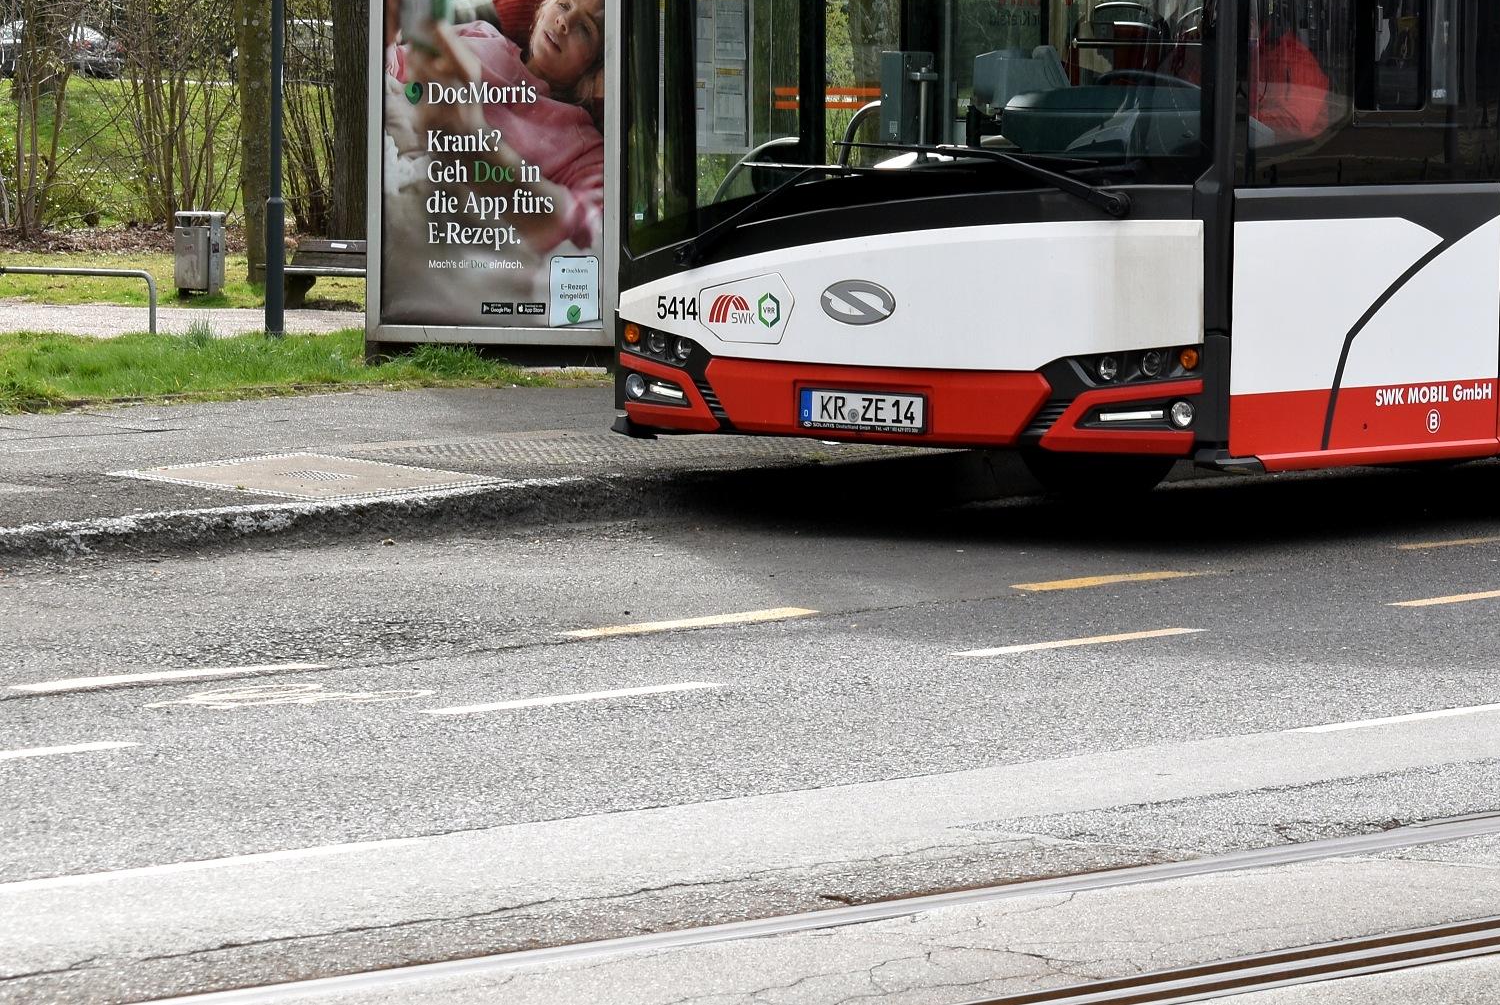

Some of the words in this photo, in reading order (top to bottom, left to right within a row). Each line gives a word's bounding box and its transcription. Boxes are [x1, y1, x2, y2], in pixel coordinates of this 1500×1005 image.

[428, 80, 536, 104] DocMorris
[427, 128, 502, 152] Krank?
[427, 160, 468, 183] Geh
[474, 160, 516, 183] Doc
[520, 160, 540, 183] in
[426, 190, 458, 214] die
[464, 191, 508, 220] App
[512, 188, 554, 214] fürs
[428, 222, 520, 251] E-Rezept.
[428, 260, 457, 269] Mach's
[458, 260, 469, 268] dir
[471, 259, 488, 268] Doc
[490, 259, 524, 269] einfach.
[657, 296, 698, 320] 5414
[732, 312, 755, 324] SWK
[763, 306, 776, 314] VRR
[1376, 388, 1404, 406] SWK
[1408, 385, 1449, 404] MOBIL
[1453, 383, 1492, 402] GmbH
[820, 396, 846, 420] KR
[861, 398, 886, 423] ZE
[892, 399, 915, 425] 14
[1429, 413, 1438, 430] B
